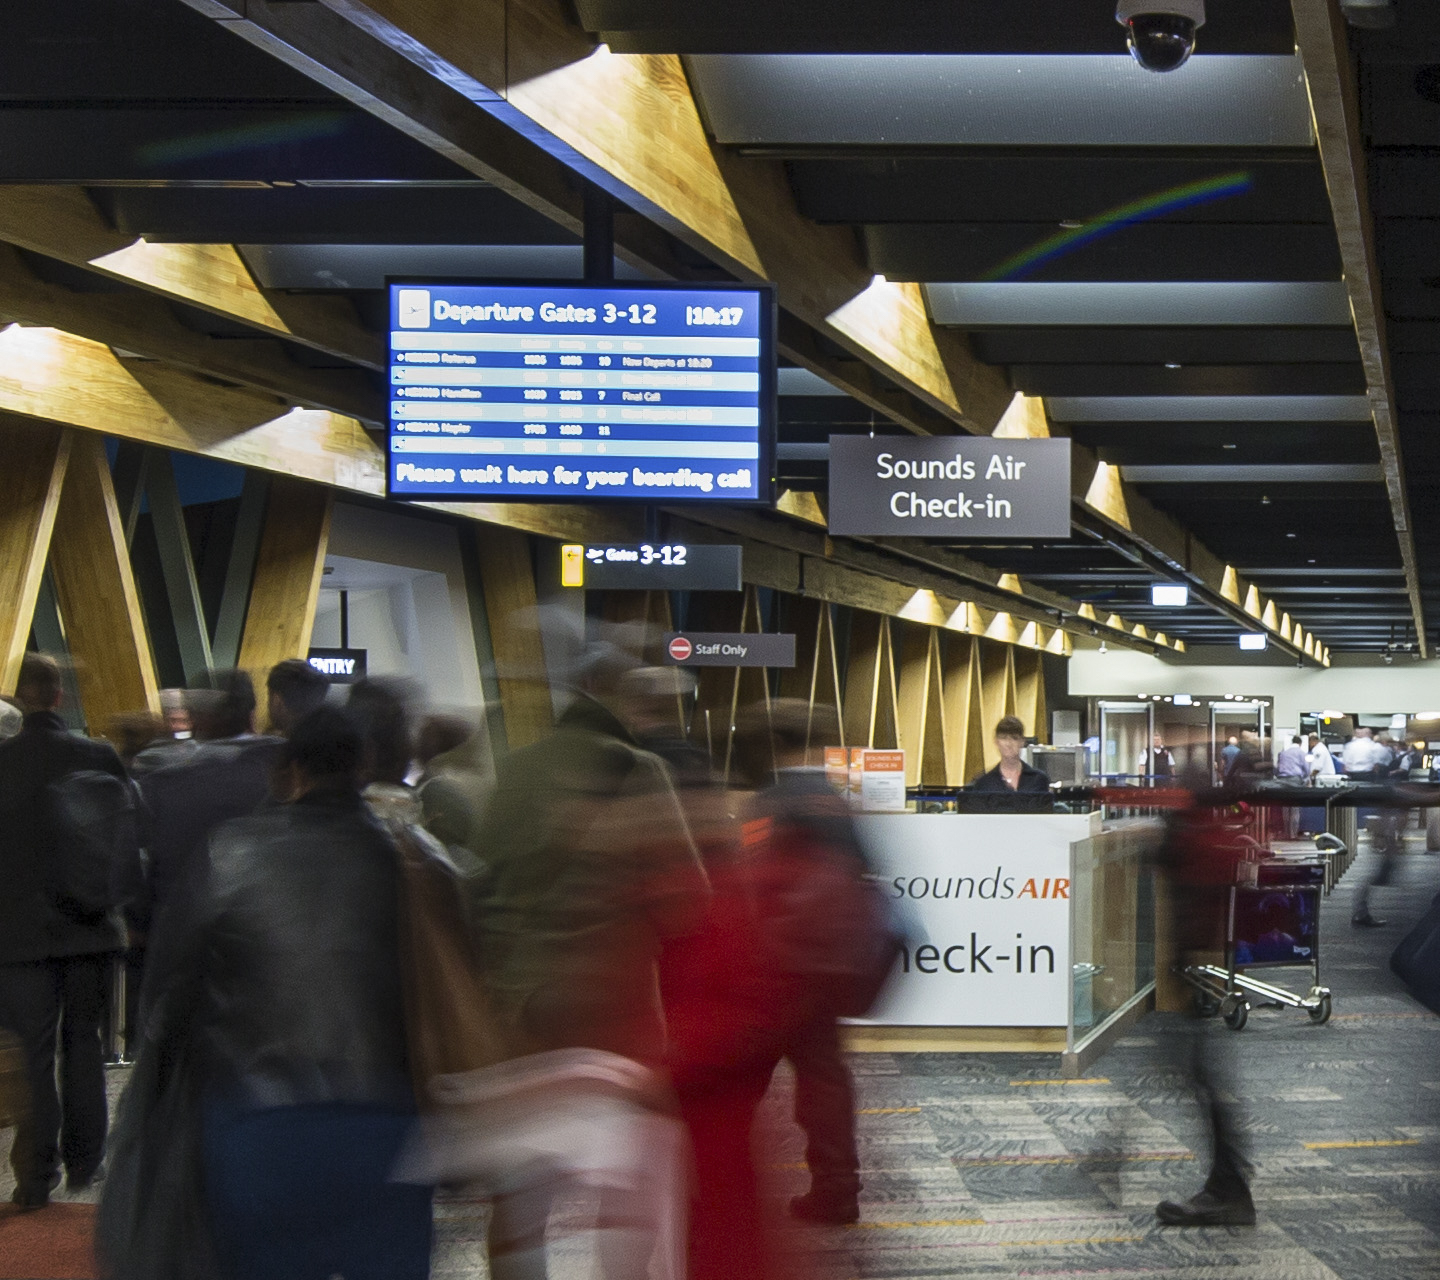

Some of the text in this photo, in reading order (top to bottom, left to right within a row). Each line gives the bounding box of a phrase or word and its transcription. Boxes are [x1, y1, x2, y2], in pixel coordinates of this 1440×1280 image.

[433, 300, 535, 325] Departure
[539, 302, 597, 323] Gates
[602, 303, 657, 325] 3-12
[396, 463, 752, 493] Please wait here for your boarding call
[876, 452, 1027, 480] Sounds Air
[890, 491, 1012, 519] Check-in
[640, 544, 687, 566] 3-12
[695, 644, 748, 657] Staff Only
[898, 931, 1056, 974] eck-in
